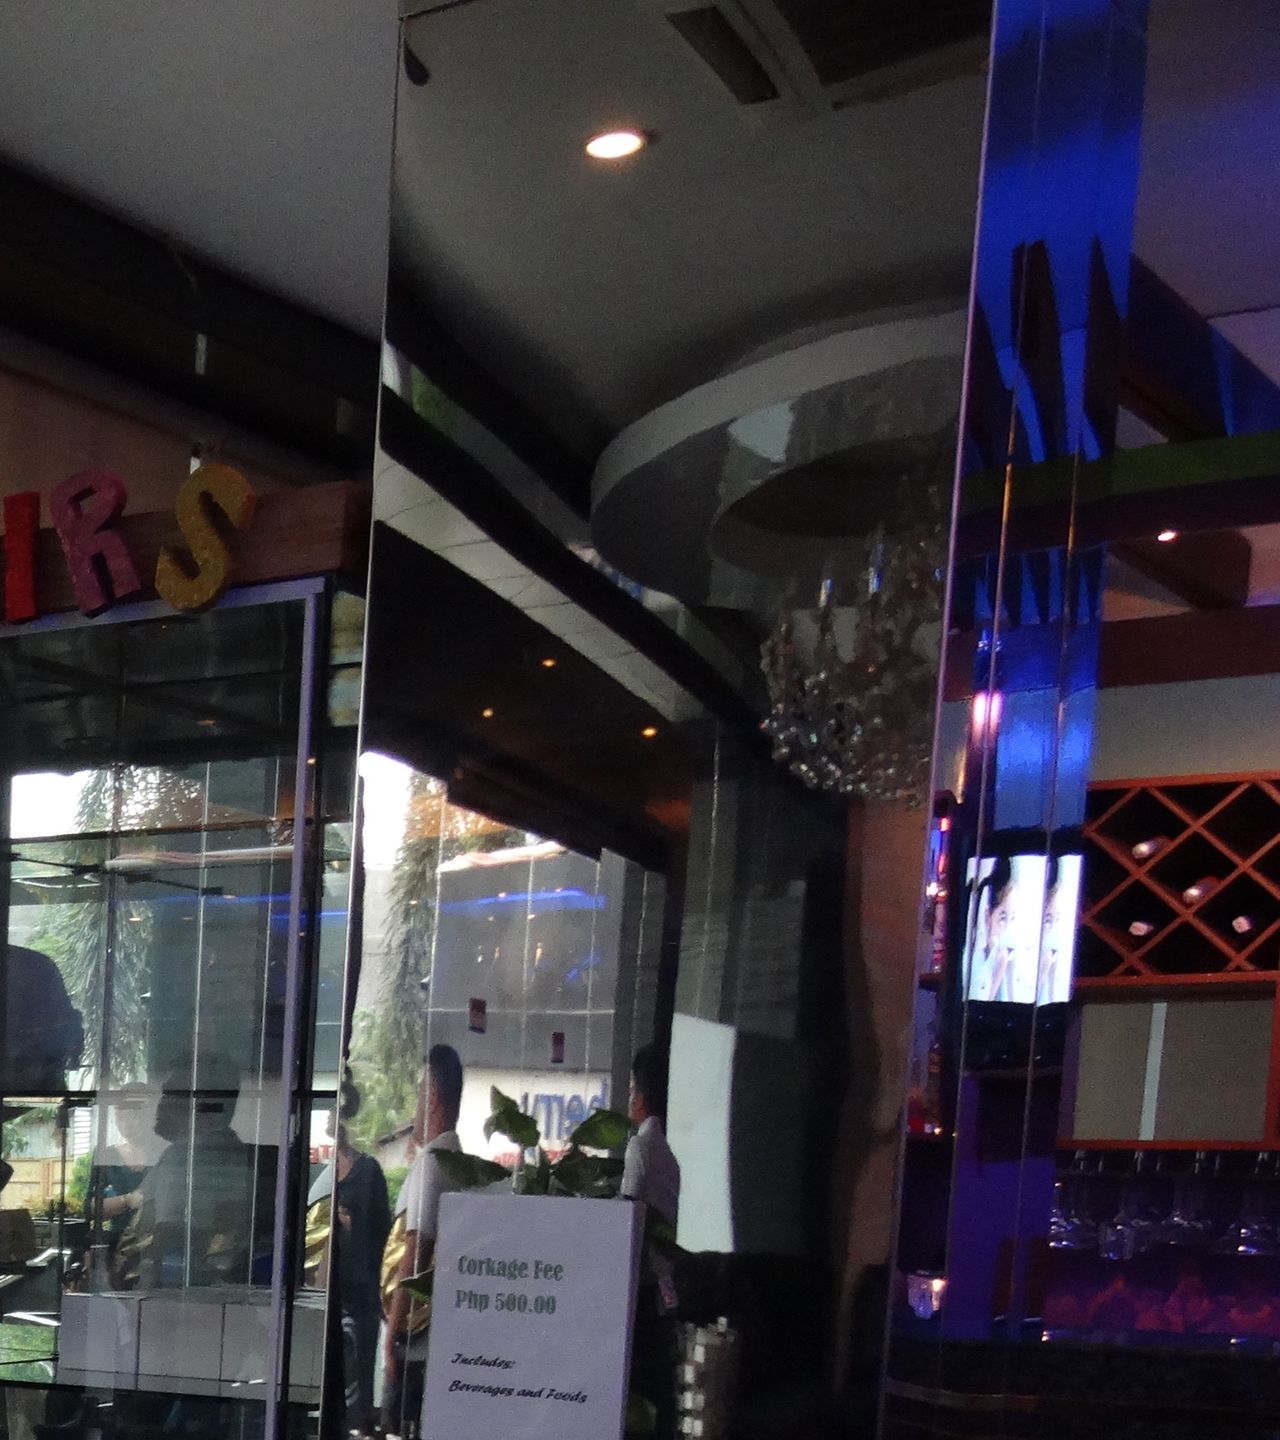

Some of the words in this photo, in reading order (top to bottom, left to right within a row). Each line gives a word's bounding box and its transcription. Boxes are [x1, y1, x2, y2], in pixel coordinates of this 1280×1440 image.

[457, 1255, 528, 1280] Corkage
[534, 1260, 563, 1281] Fee
[454, 1289, 488, 1312] Php
[495, 1293, 556, 1314] 500.00
[451, 1353, 515, 1369] Includes:
[449, 1380, 514, 1396] Beverages
[517, 1388, 543, 1398] and
[546, 1389, 587, 1403] Foods
